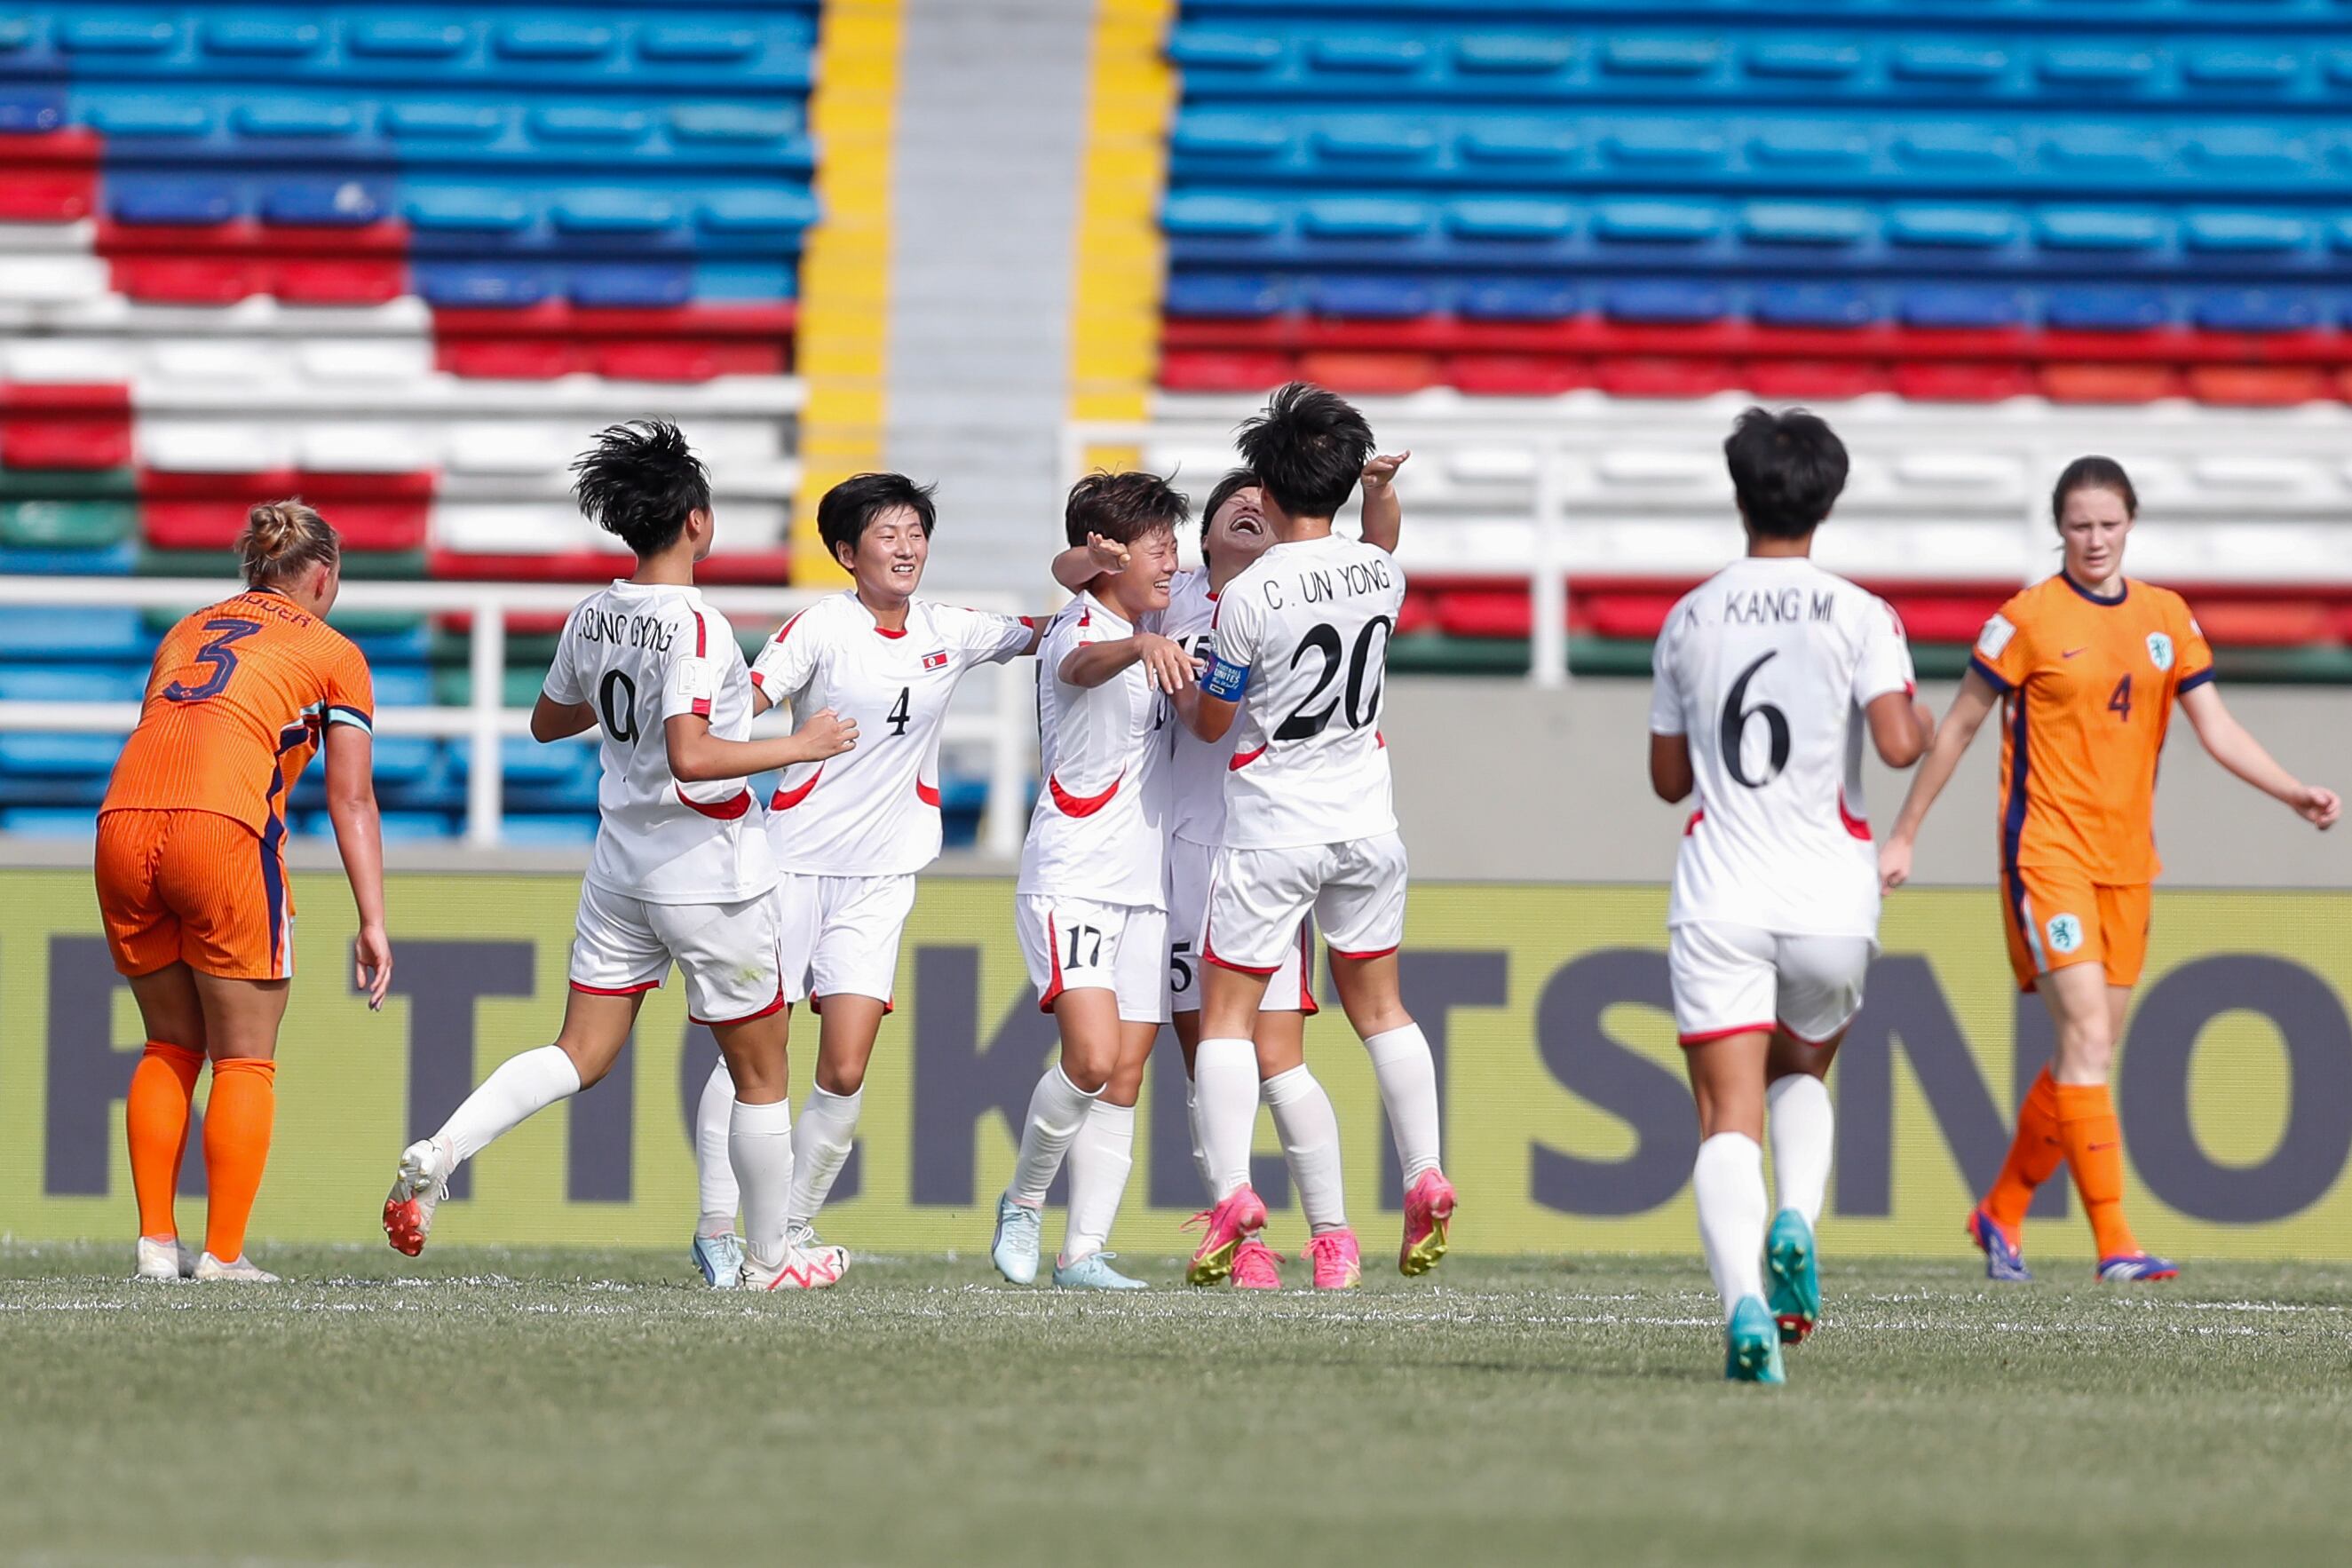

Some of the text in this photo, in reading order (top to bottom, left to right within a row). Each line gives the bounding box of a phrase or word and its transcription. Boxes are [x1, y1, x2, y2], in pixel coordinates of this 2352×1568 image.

[1299, 569, 1334, 604] UN
[1336, 559, 1390, 598] YONG
[1723, 588, 1802, 624] KANG
[1809, 589, 1835, 622] MI
[162, 618, 264, 701] 3
[1272, 614, 1391, 741] 20
[886, 686, 911, 736] 4
[1721, 649, 1791, 788] 6
[2108, 673, 2132, 723] 4
[1064, 923, 1102, 970] 17
